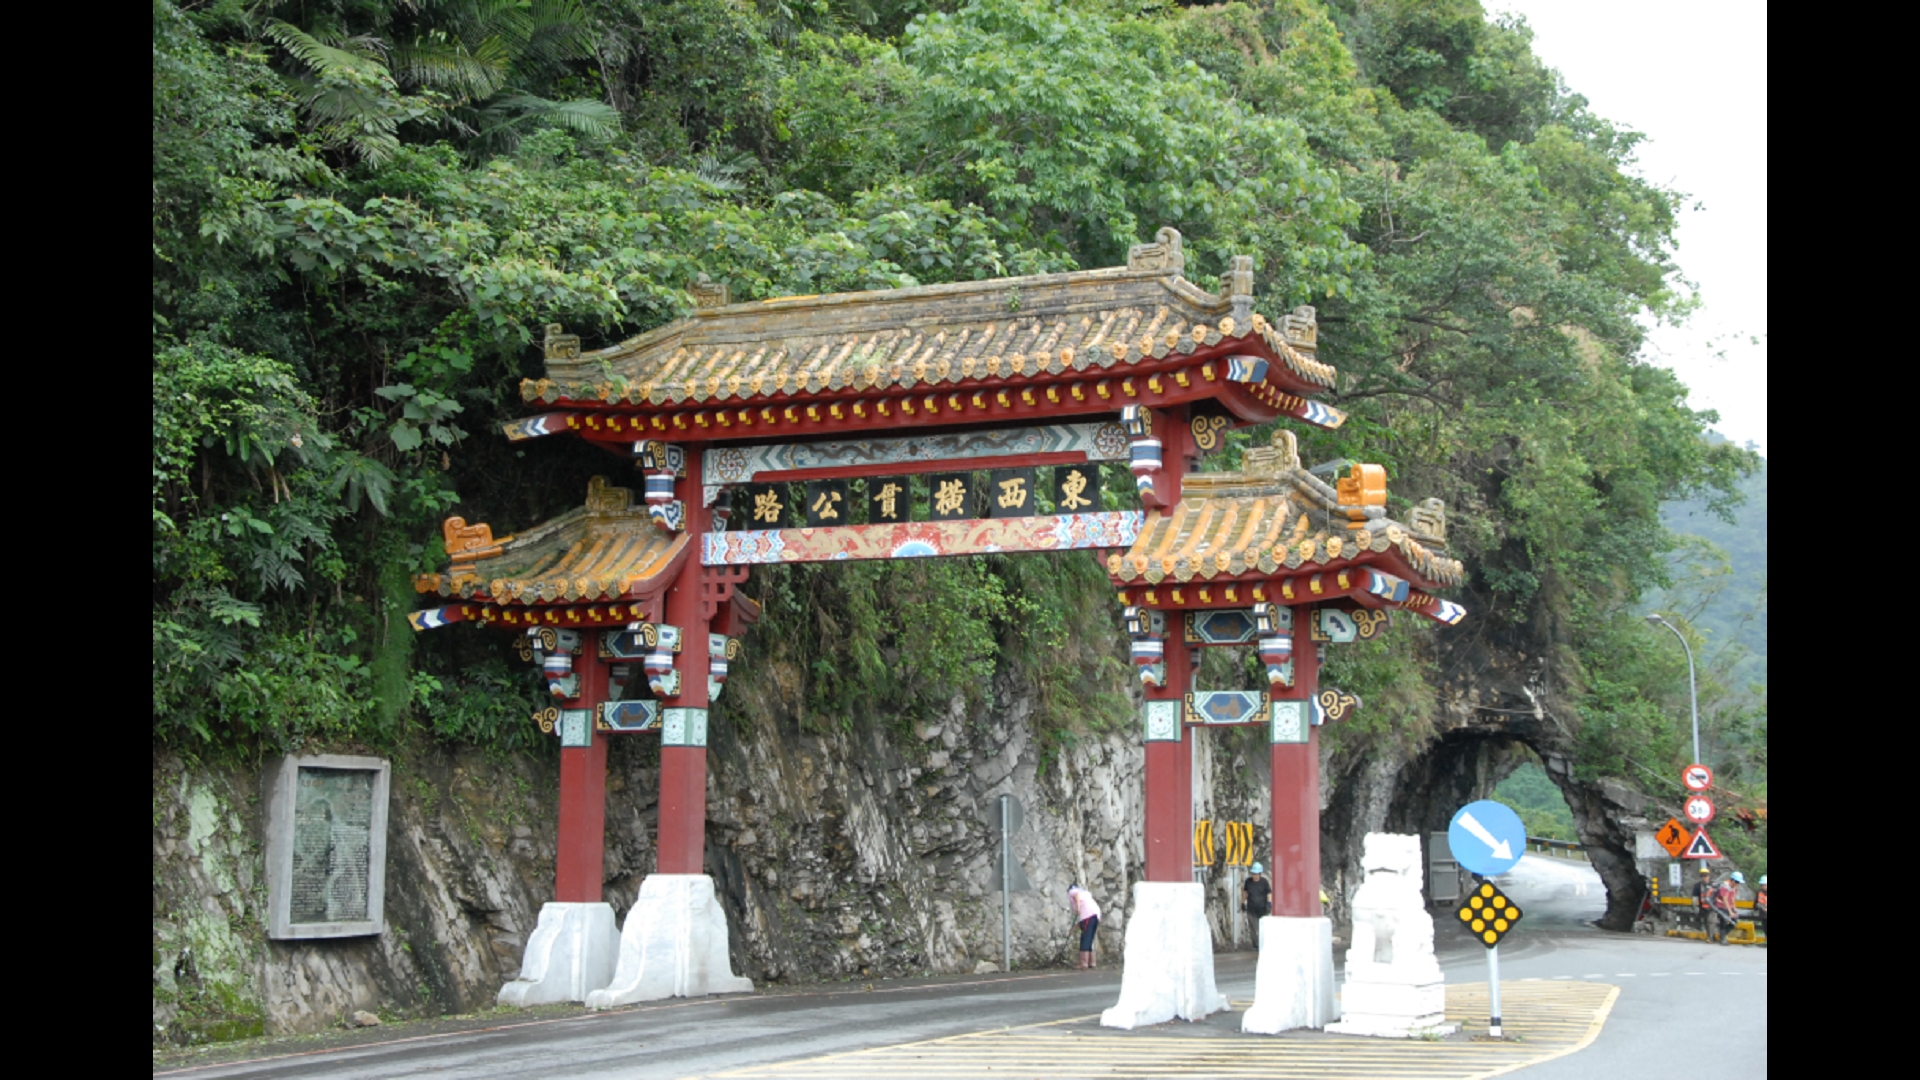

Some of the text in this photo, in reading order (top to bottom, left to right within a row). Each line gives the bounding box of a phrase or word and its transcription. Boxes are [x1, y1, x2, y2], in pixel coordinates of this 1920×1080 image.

[753, 469, 1092, 523] 東西橫貫公路
